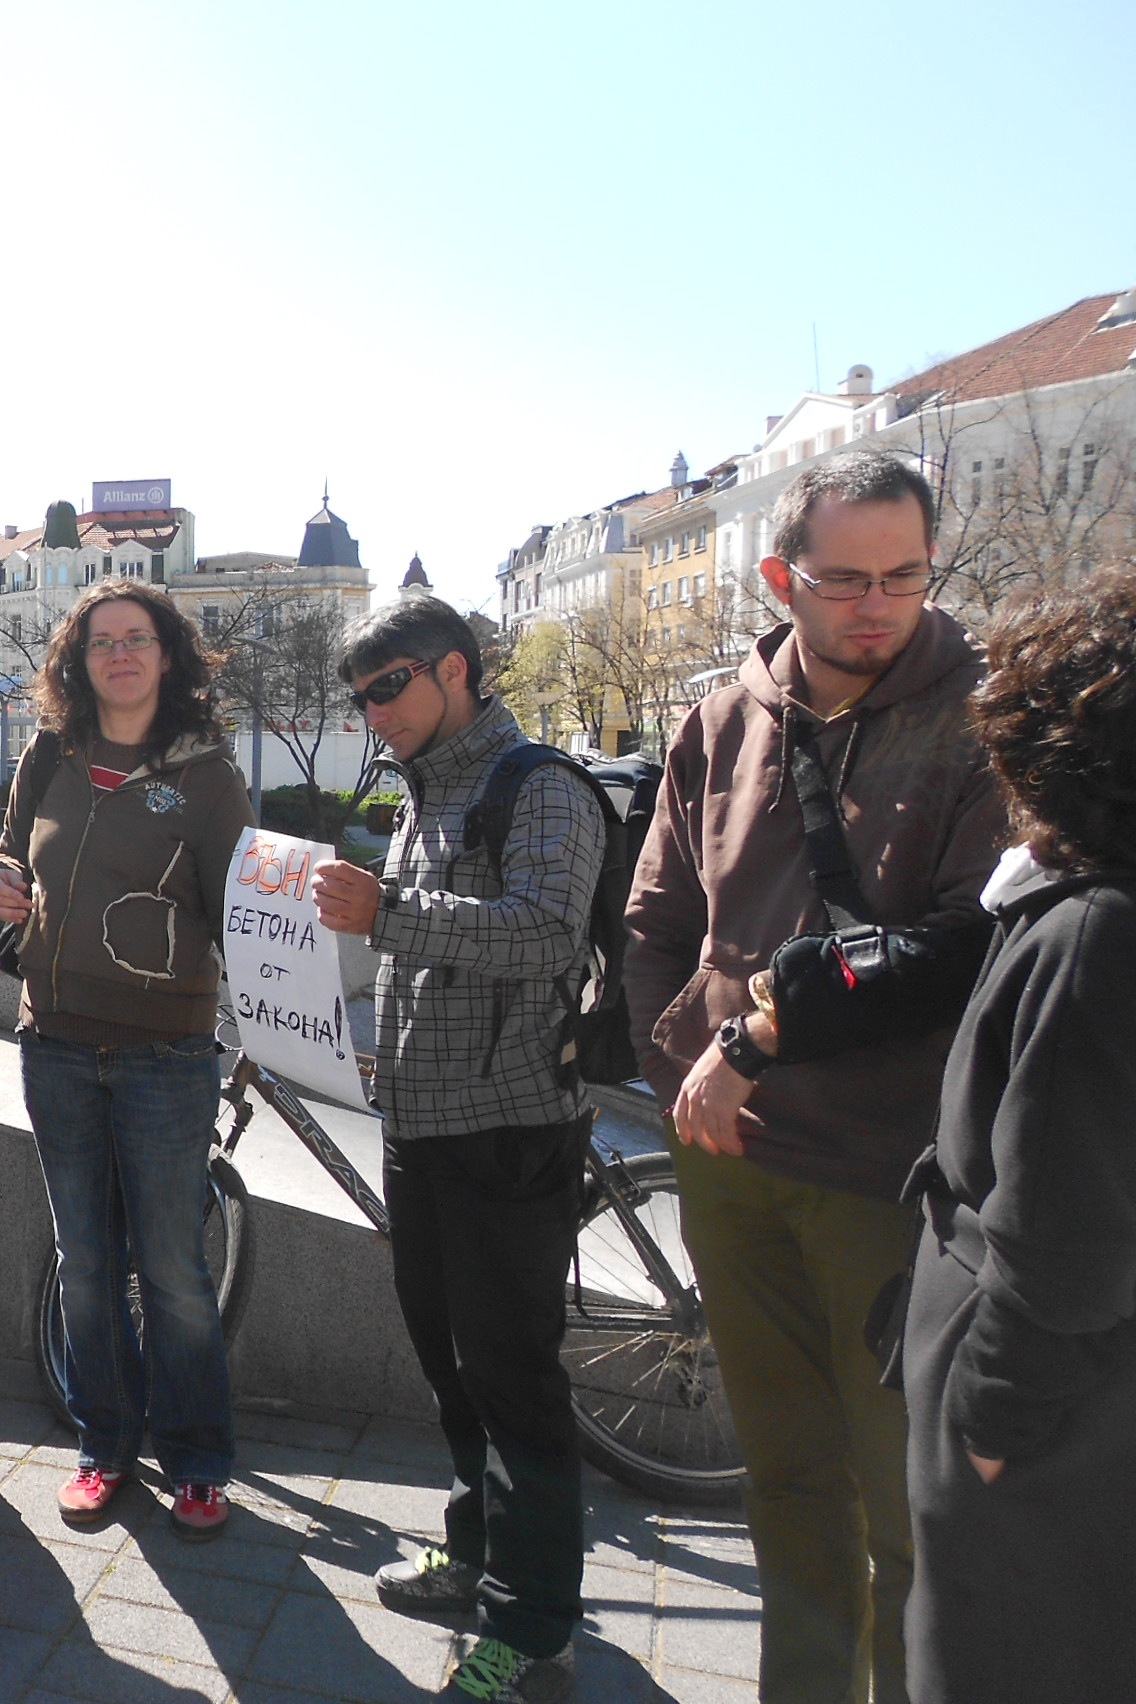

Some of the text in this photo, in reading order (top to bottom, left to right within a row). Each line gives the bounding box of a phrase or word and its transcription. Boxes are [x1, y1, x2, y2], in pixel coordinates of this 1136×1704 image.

[103, 490, 147, 503] Allianz
[236, 835, 311, 902] ВЪН
[227, 905, 317, 953] БЕТОНА
[237, 993, 347, 1061] ЗАКОНА!
